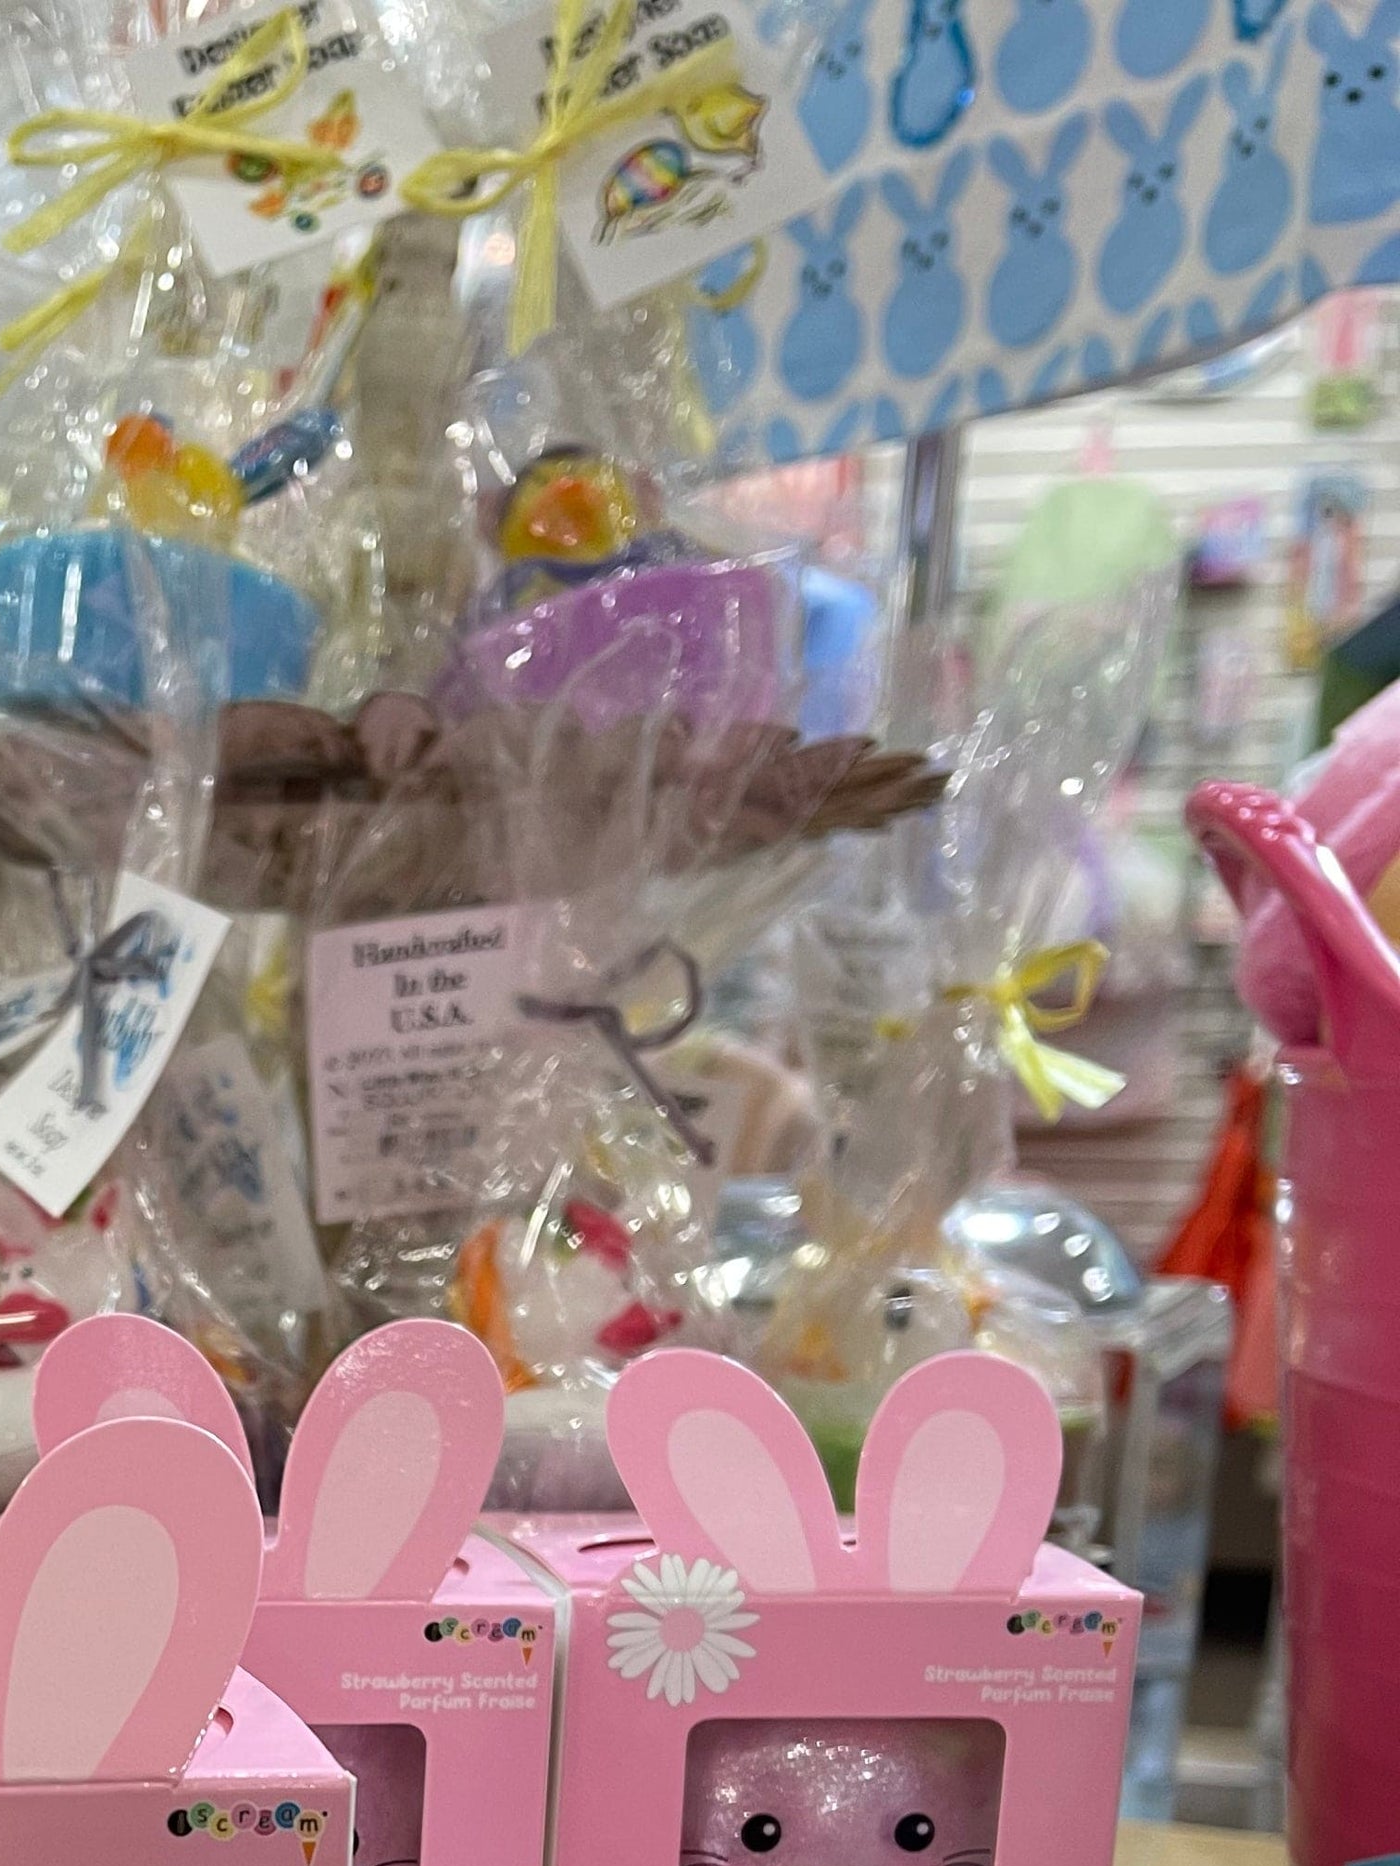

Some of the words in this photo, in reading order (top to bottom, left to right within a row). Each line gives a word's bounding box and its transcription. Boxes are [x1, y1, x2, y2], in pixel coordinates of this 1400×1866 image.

[428, 969, 467, 993] the
[341, 1672, 454, 1692] Strawberry
[461, 1671, 538, 1690] Scented
[924, 1665, 1035, 1685] Strawberry
[1041, 1665, 1117, 1683] Scented
[399, 1693, 472, 1713] Parfum
[478, 1693, 536, 1710] Fraise
[981, 1686, 1051, 1706] Parfum
